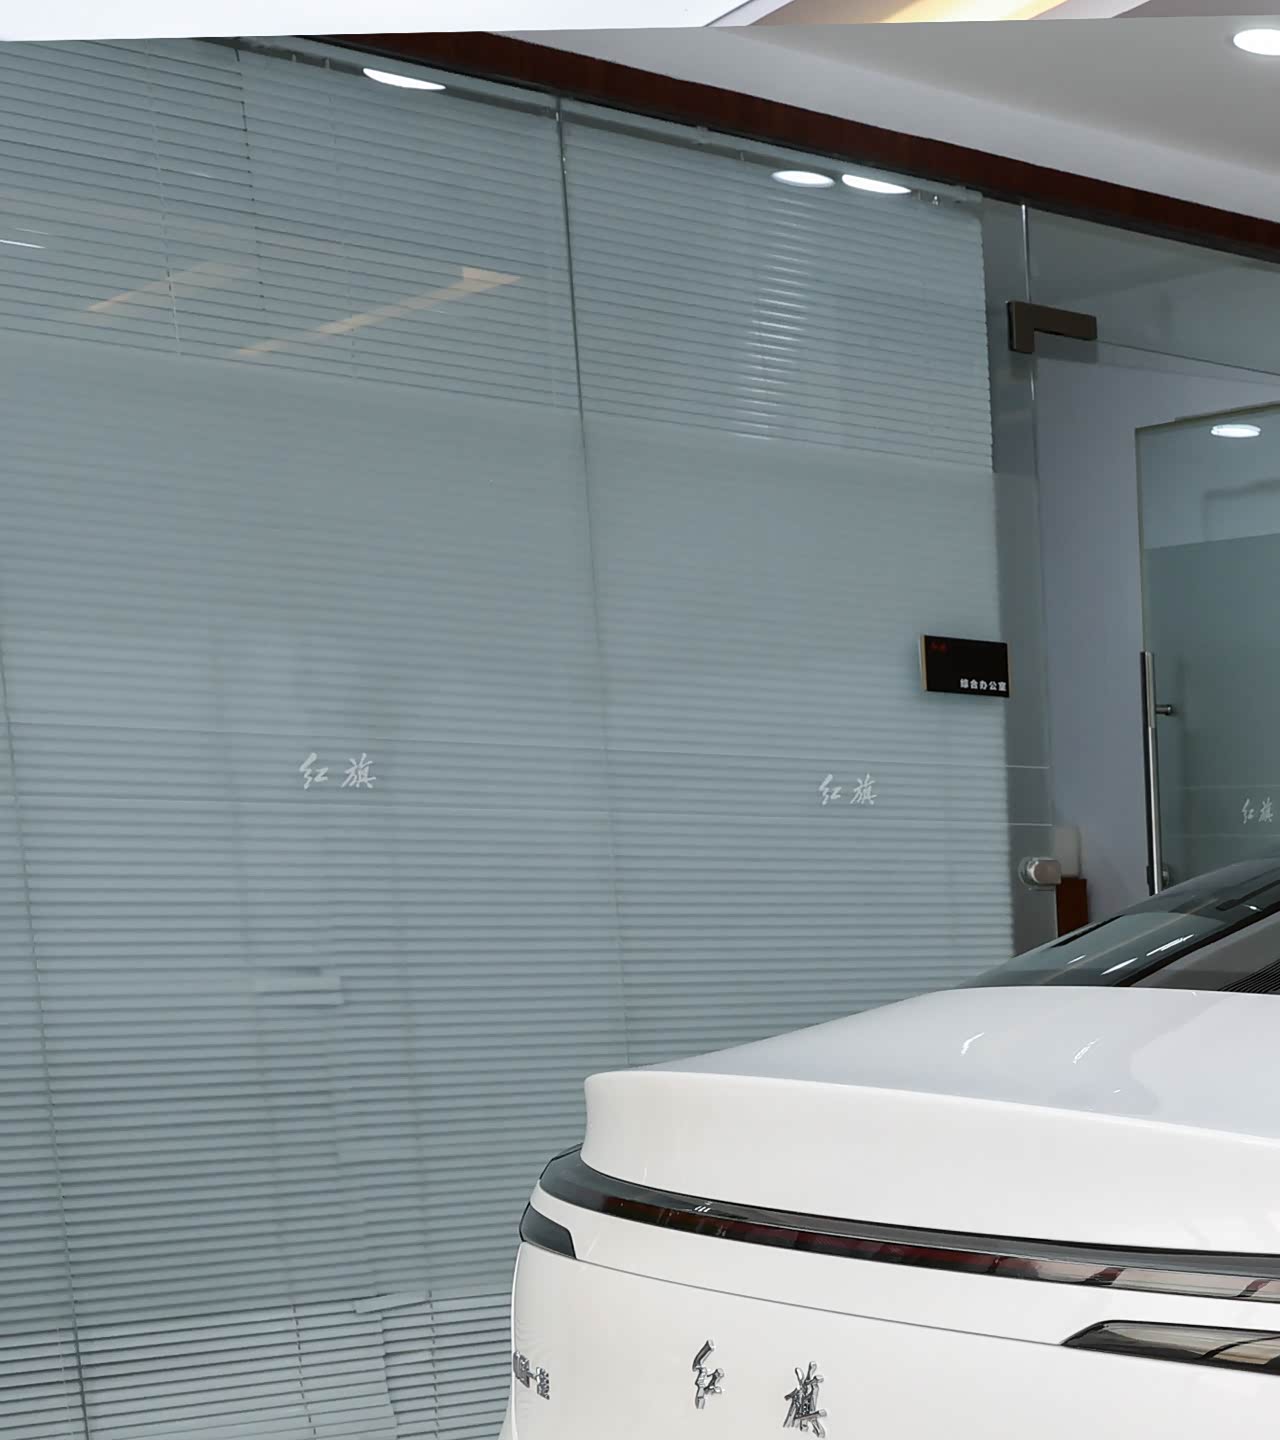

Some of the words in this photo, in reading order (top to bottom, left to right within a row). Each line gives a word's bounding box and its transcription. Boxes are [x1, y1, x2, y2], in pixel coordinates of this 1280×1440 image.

[960, 678, 1007, 692] 综合办公室
[300, 752, 377, 790] 红旗
[819, 774, 878, 806] 红旗
[1241, 797, 1274, 824] 红旗
[692, 1339, 828, 1439] 红旗
